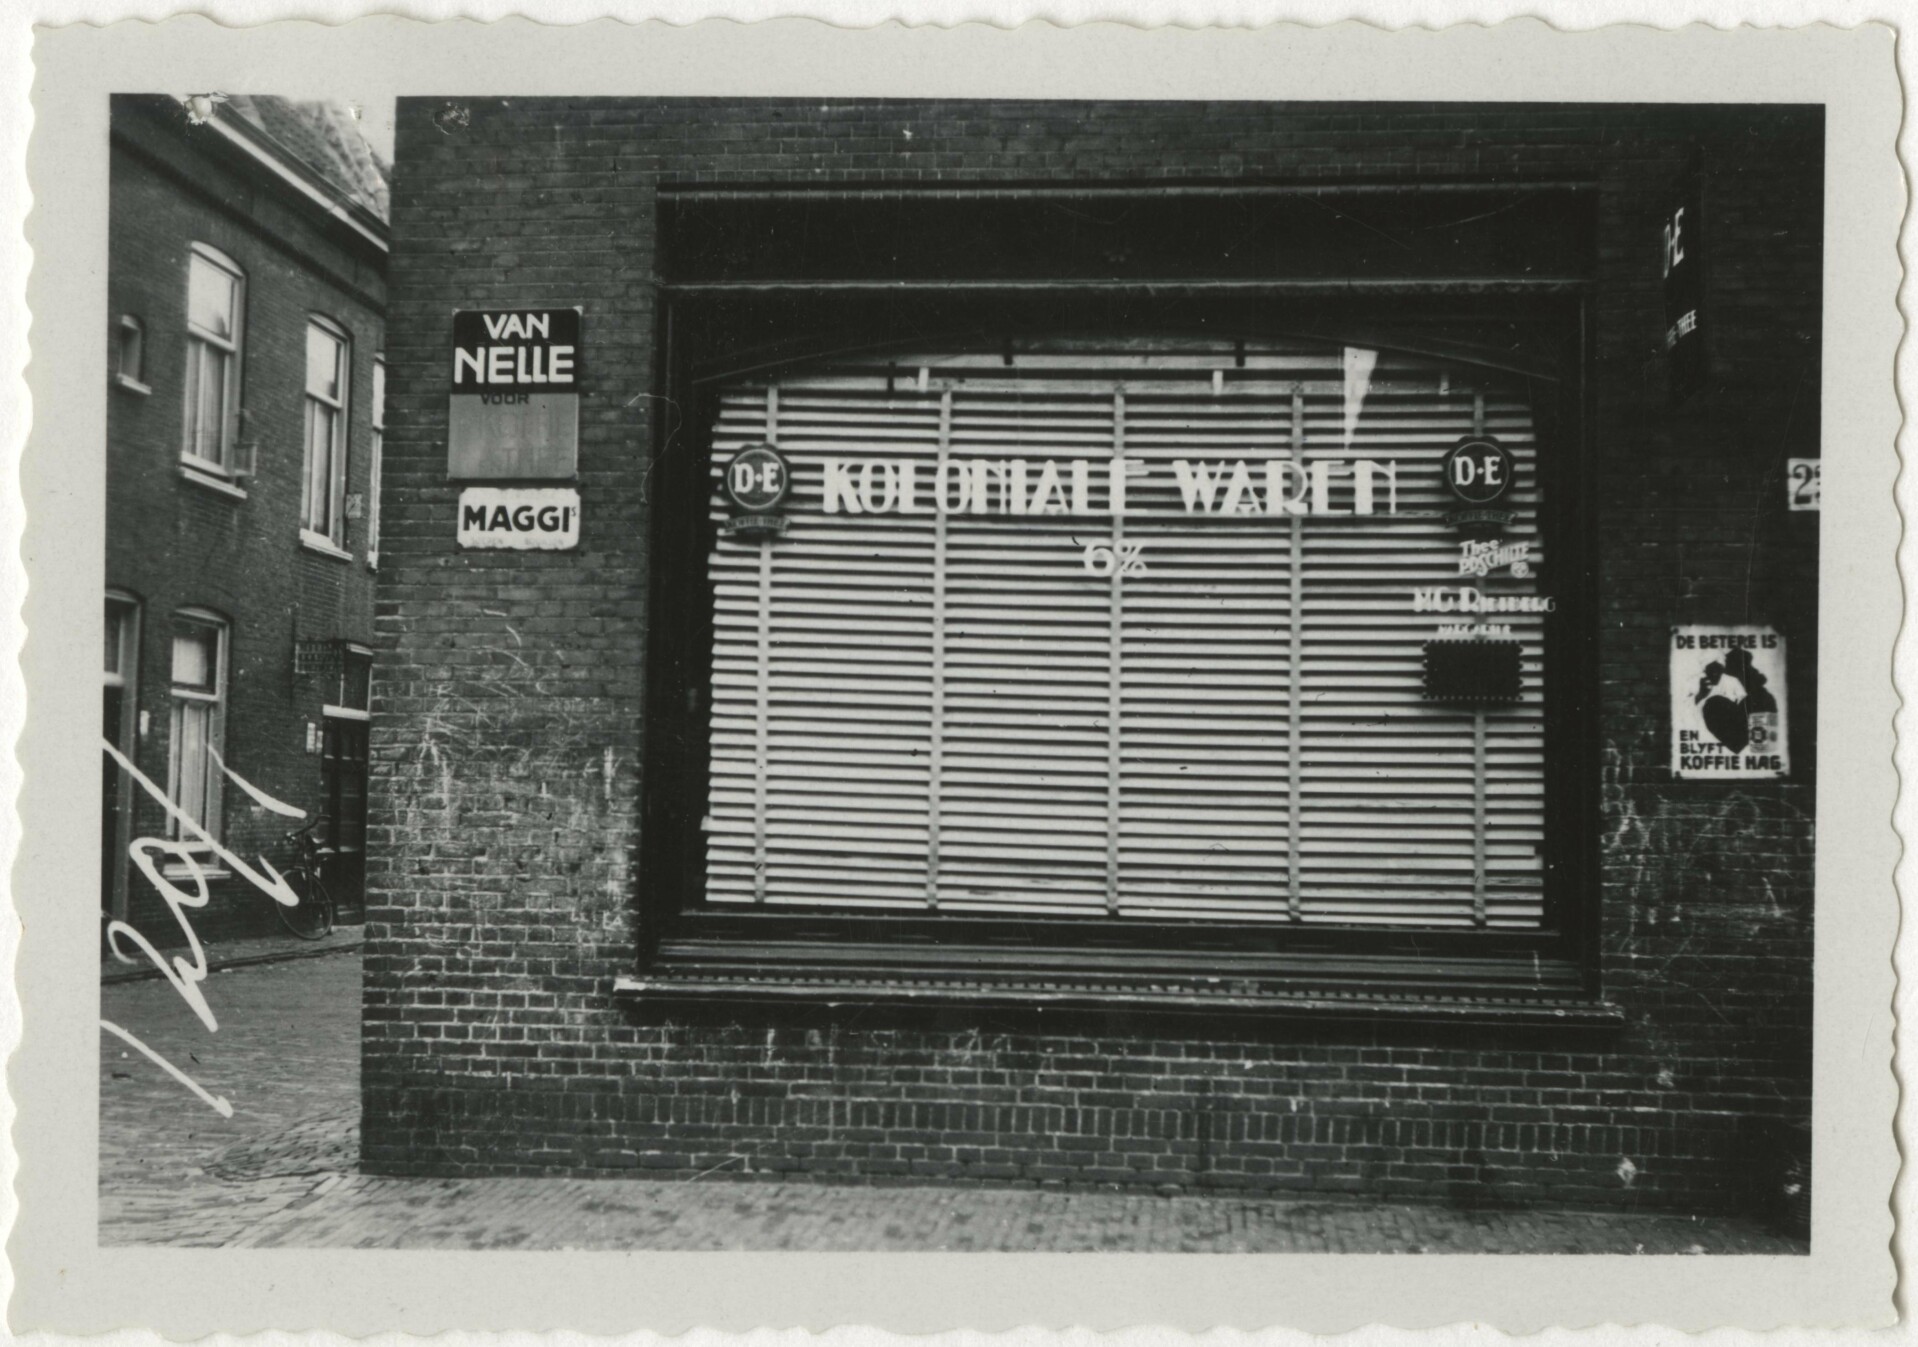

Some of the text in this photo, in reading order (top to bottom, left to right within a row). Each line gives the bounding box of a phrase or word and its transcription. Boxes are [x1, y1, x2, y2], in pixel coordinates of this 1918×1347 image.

[483, 313, 549, 339] VAN
[454, 345, 575, 384] NELLE
[480, 393, 530, 406] VOOR
[822, 457, 1398, 517] KOLONIALE WAREN
[1084, 538, 1149, 578] 6%
[1676, 634, 1777, 649] DE BETERE IS
[1680, 730, 1699, 741] EN
[1680, 755, 1782, 770] KOFFIE HAG
